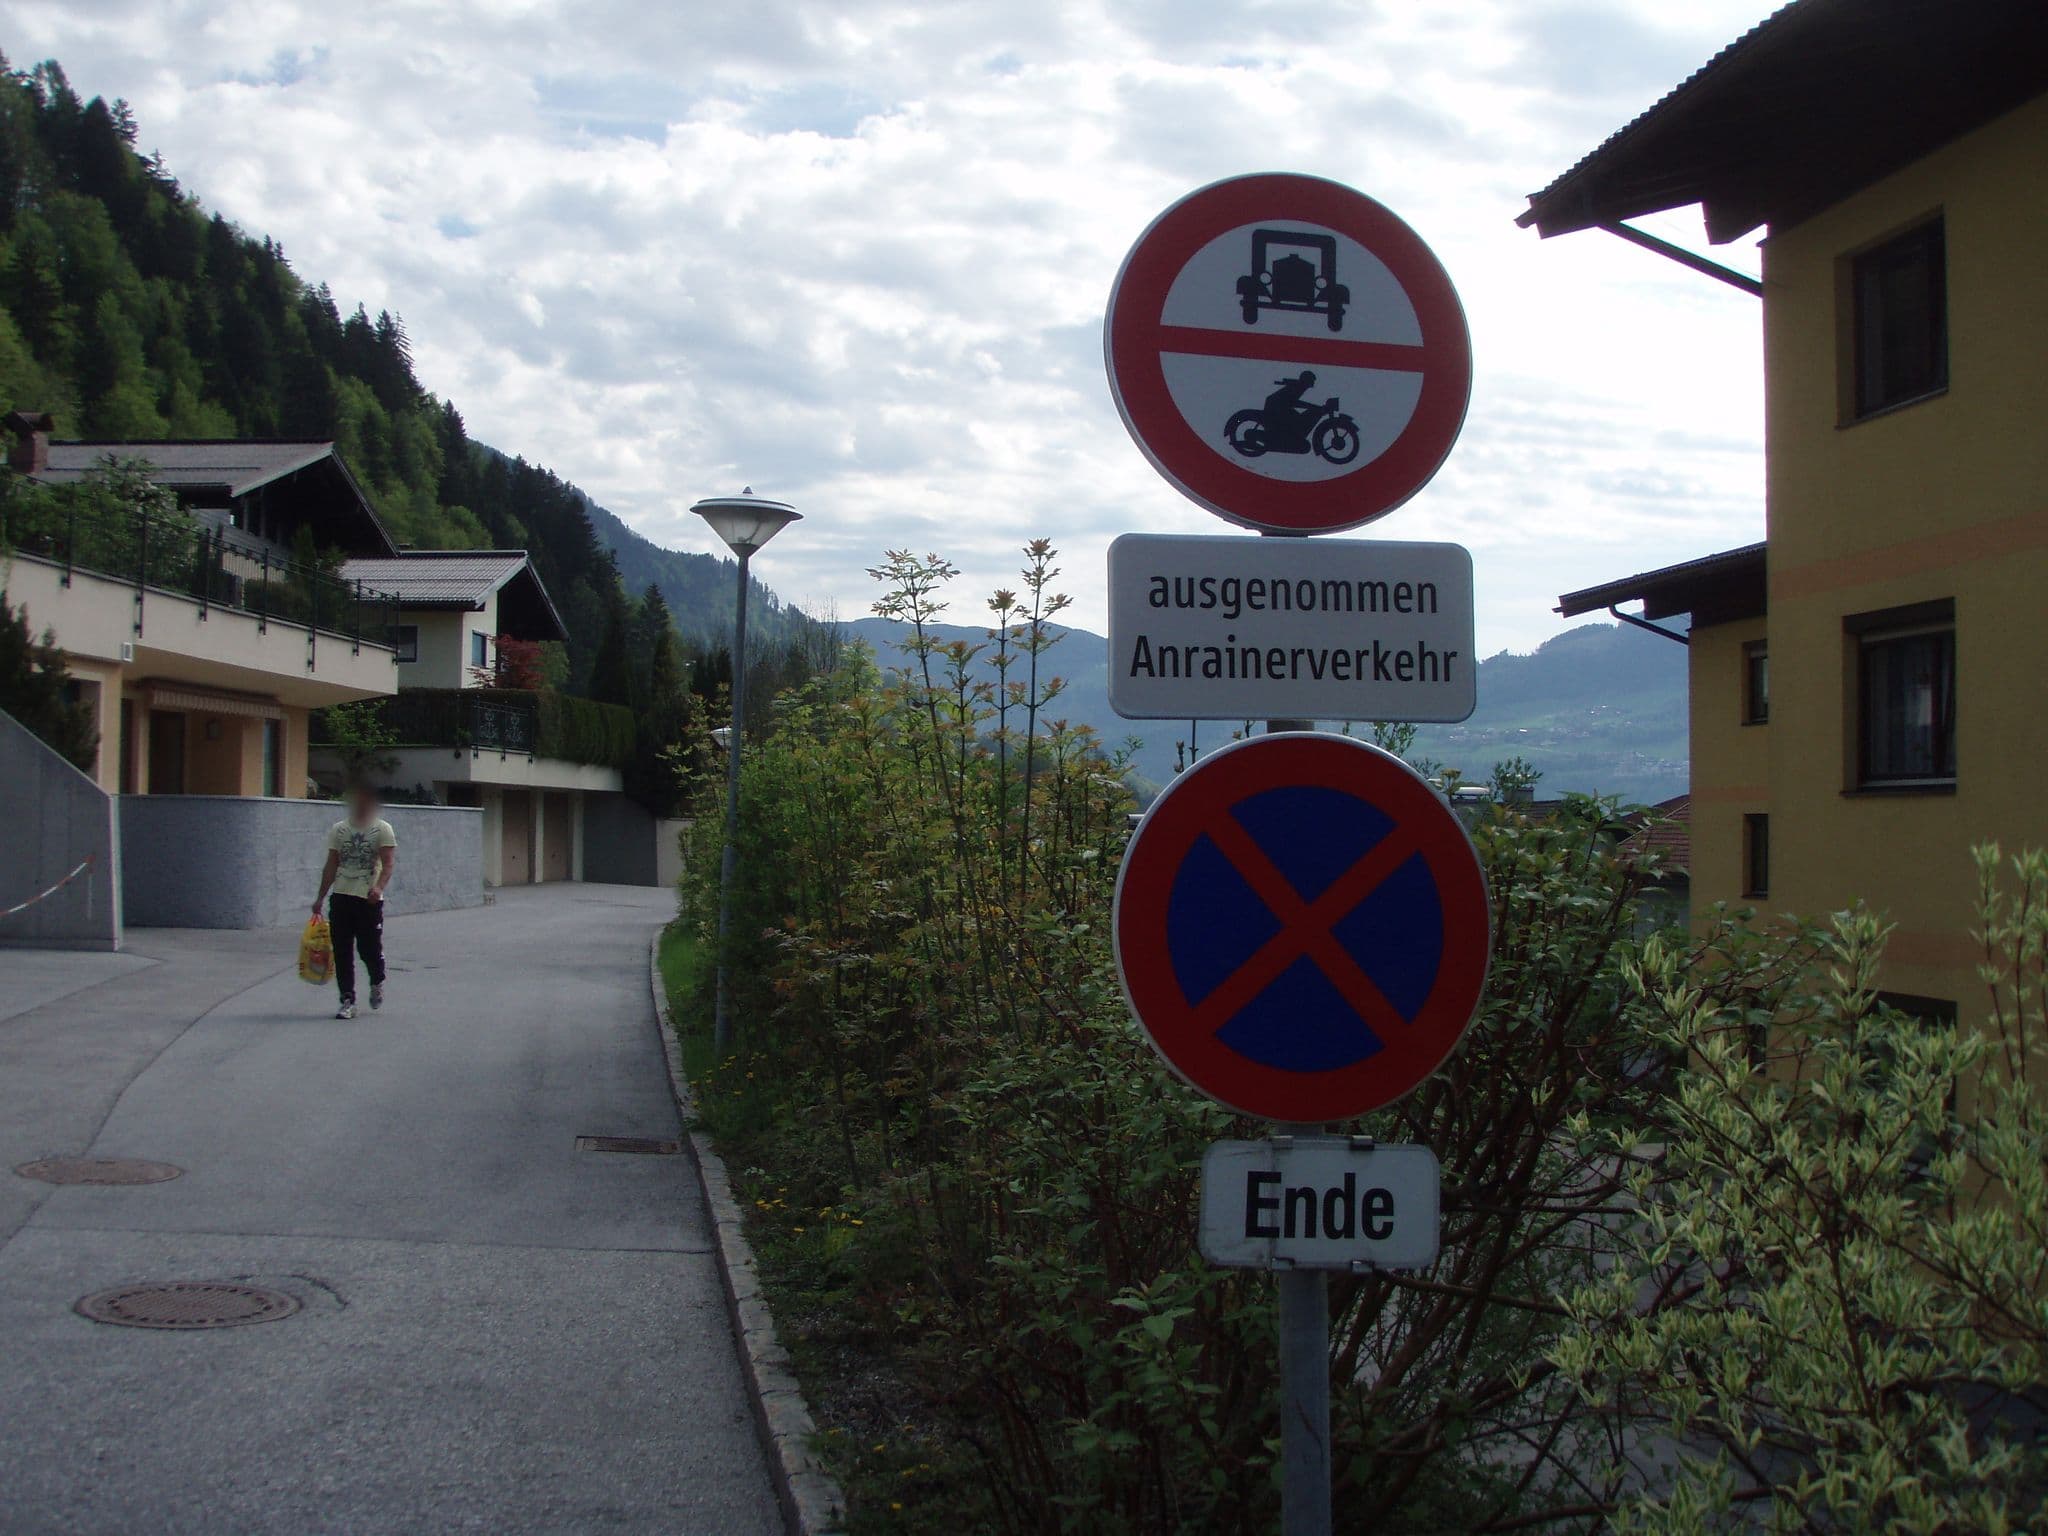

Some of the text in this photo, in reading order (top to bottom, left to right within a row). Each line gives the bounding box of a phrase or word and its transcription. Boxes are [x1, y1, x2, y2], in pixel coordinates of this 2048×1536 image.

[1148, 575, 1438, 619] ausgenommen
[1130, 635, 1458, 683] Anrainerverkehr
[1245, 1171, 1394, 1240] Ende
